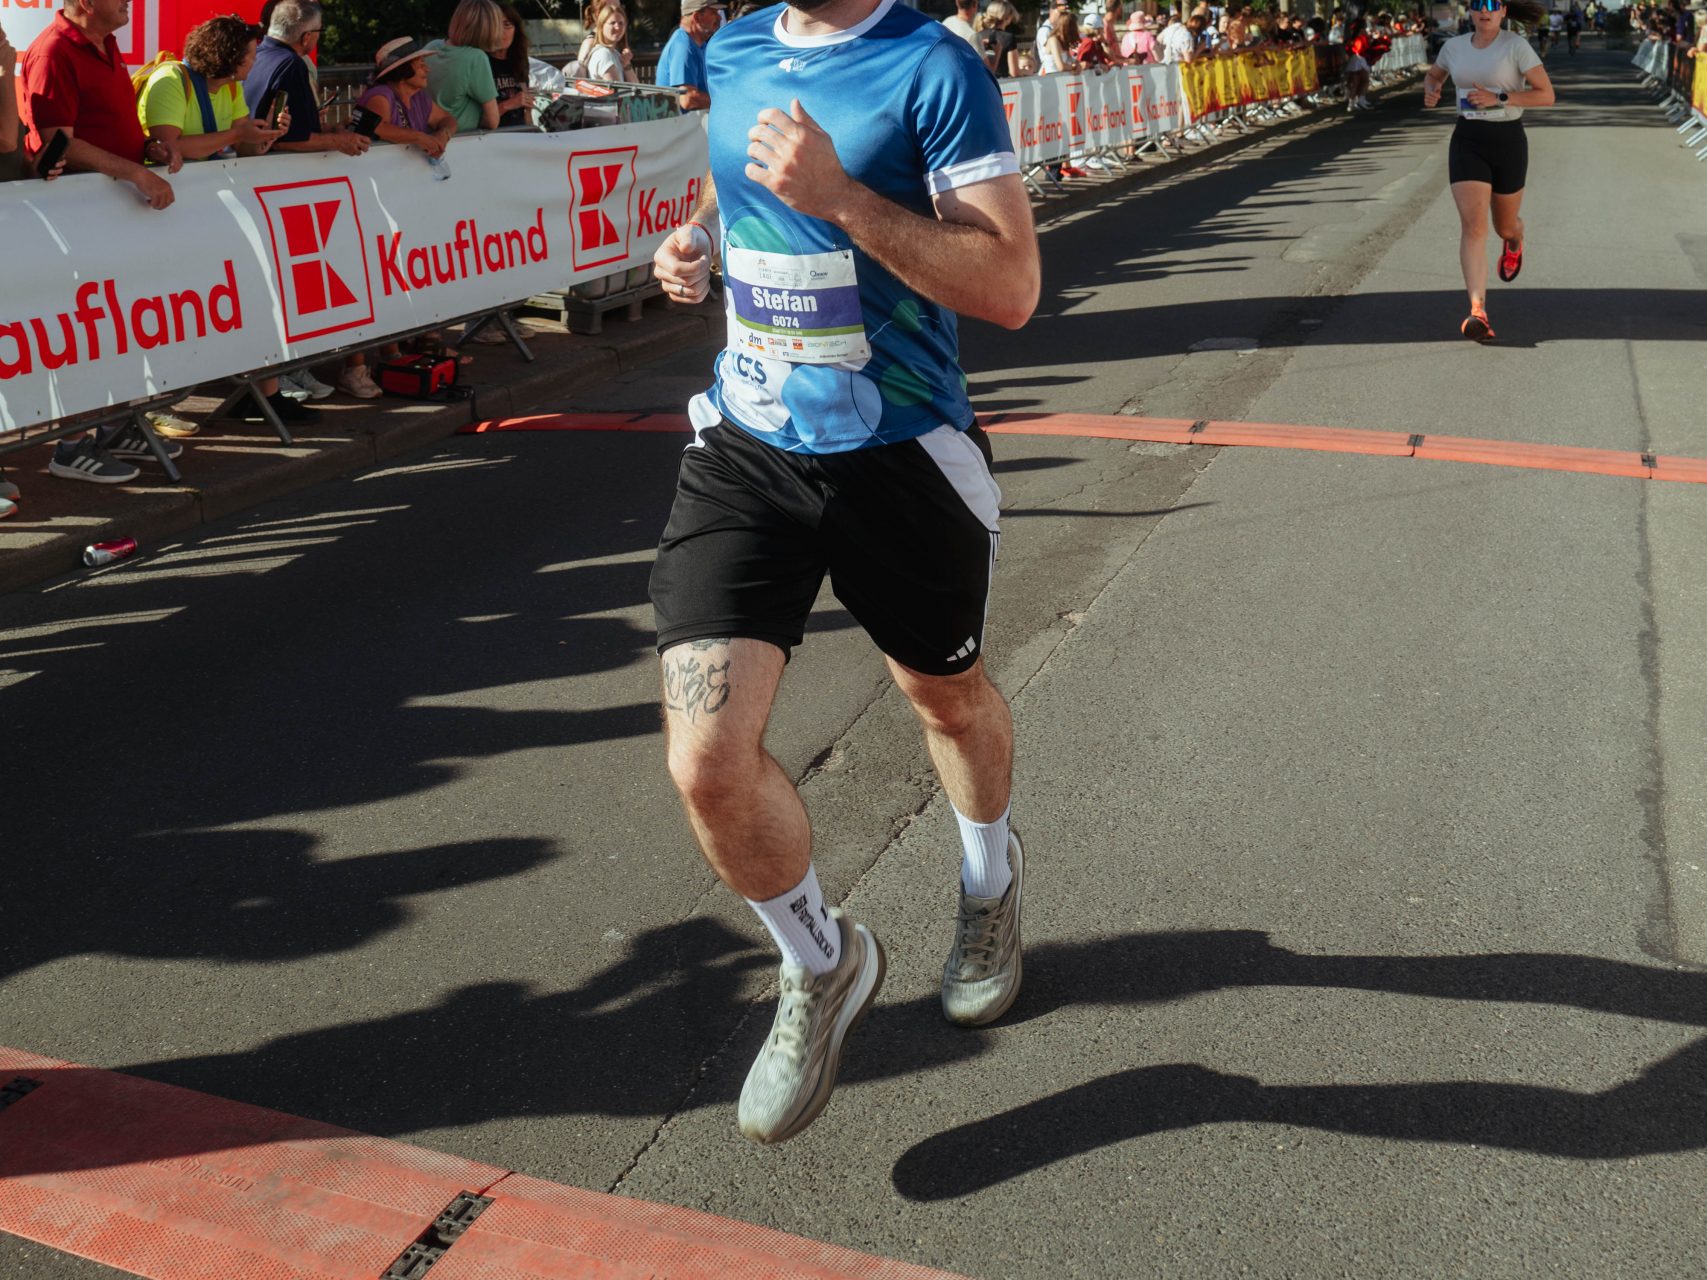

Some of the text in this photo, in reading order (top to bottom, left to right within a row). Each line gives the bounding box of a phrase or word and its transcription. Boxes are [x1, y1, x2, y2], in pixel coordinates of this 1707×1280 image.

[1020, 111, 1063, 148] Kaufland
[1086, 102, 1127, 132] Kaufland
[376, 207, 549, 296] Kaufland
[752, 286, 818, 312] Stefan
[0, 259, 243, 380] aufland
[772, 315, 800, 328] 6074
[749, 332, 762, 345] dm
